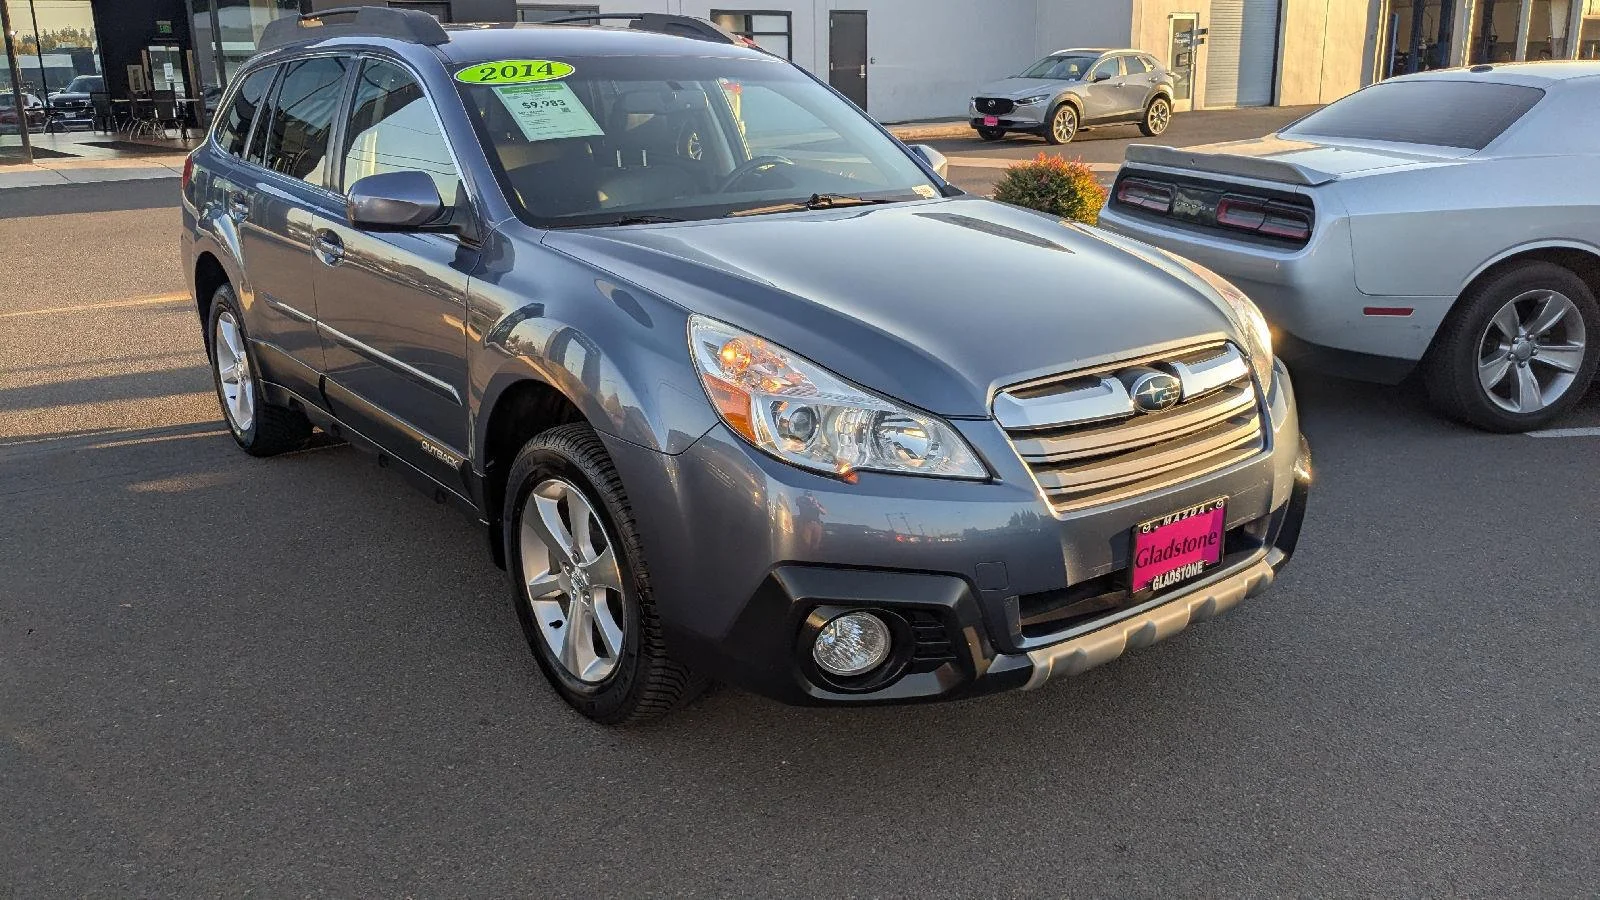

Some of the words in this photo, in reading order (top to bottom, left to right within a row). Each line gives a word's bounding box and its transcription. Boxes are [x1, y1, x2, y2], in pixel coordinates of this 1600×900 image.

[480, 63, 556, 82] 2014
[421, 440, 459, 471] OUTBACK
[1163, 505, 1206, 526] MAZDA
[1135, 531, 1218, 568] Gladstone
[1152, 560, 1204, 591] GLADSTONE
